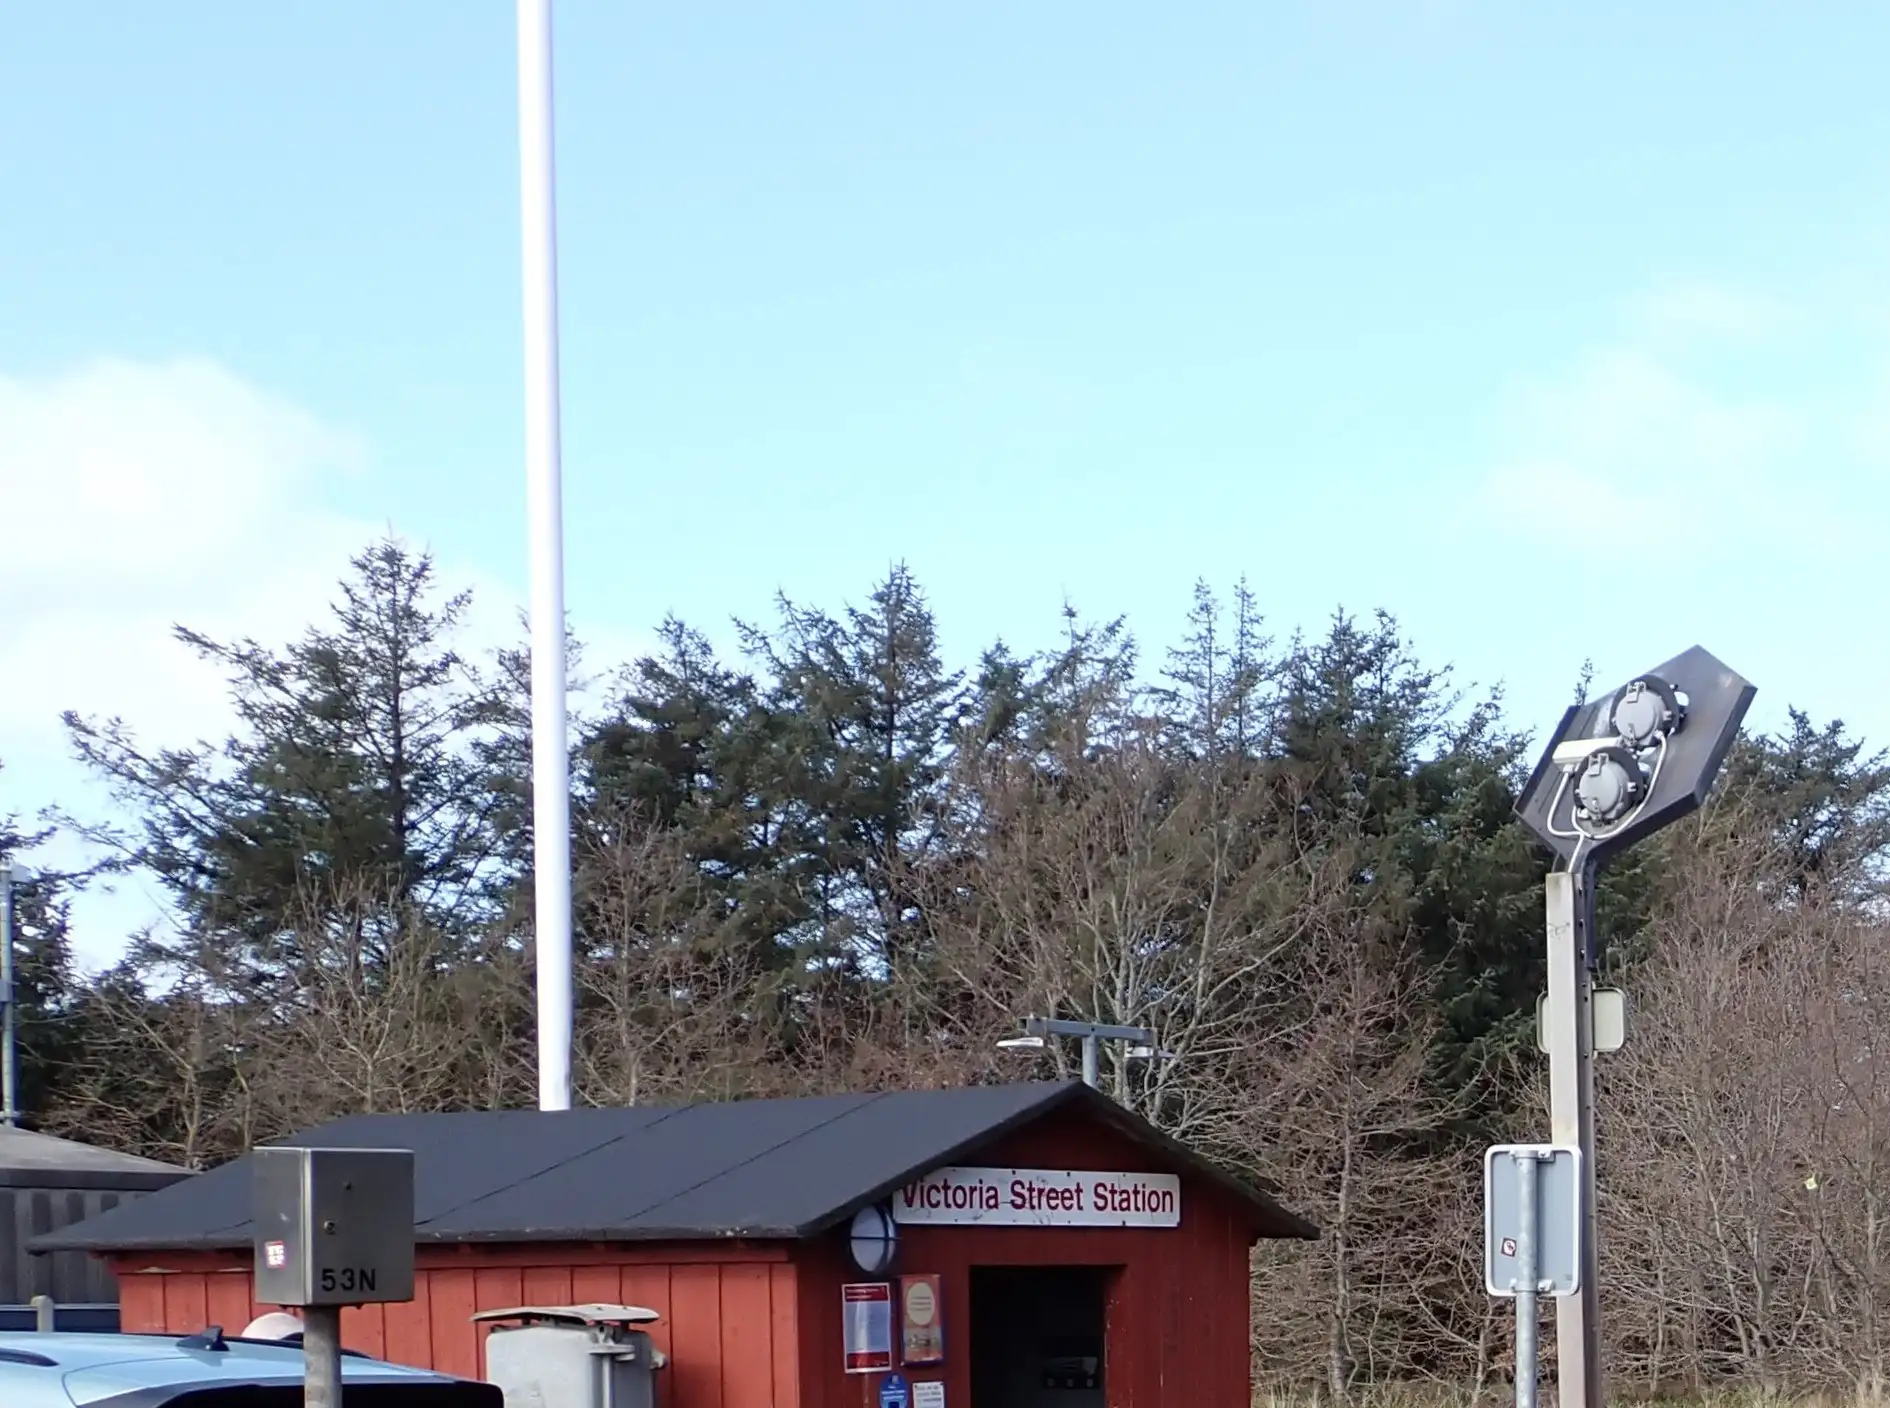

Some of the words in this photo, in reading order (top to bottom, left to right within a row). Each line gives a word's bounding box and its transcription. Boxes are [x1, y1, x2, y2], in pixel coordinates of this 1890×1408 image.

[902, 1178, 999, 1210] Victoria
[1010, 1180, 1083, 1211] Street
[1093, 1182, 1173, 1212] Station
[321, 1268, 376, 1291] 53N
